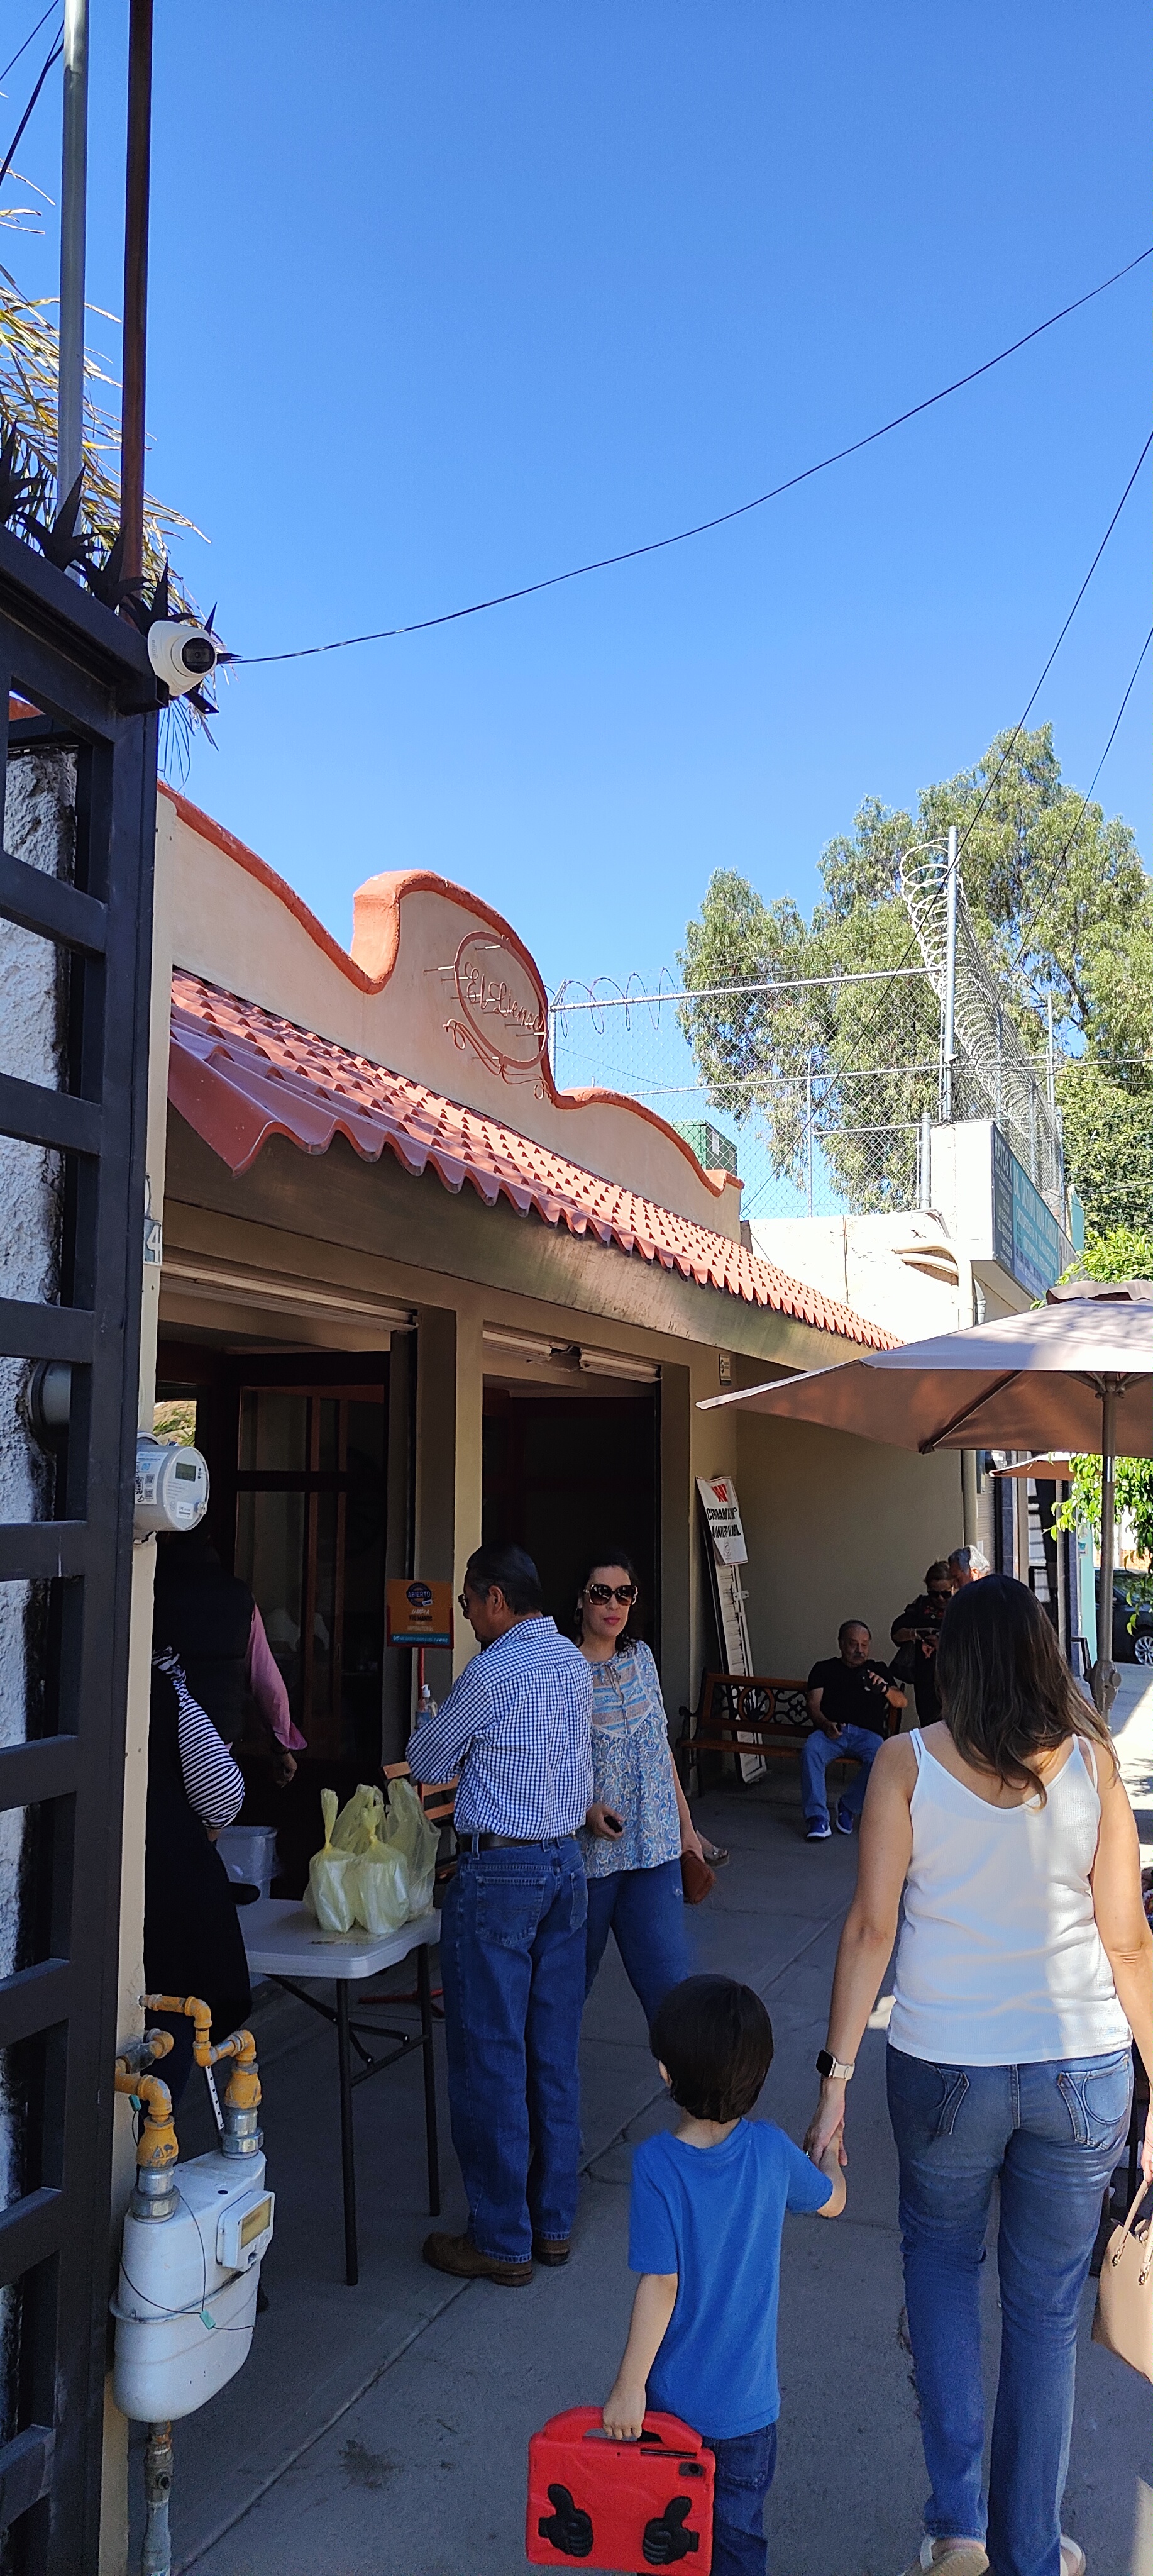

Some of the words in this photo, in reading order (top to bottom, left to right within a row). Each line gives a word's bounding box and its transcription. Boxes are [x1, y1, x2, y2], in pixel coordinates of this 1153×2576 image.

[465, 962, 488, 1010] El
[995, 1131, 1009, 1176] RAYOS
[1009, 1155, 1013, 1182] X
